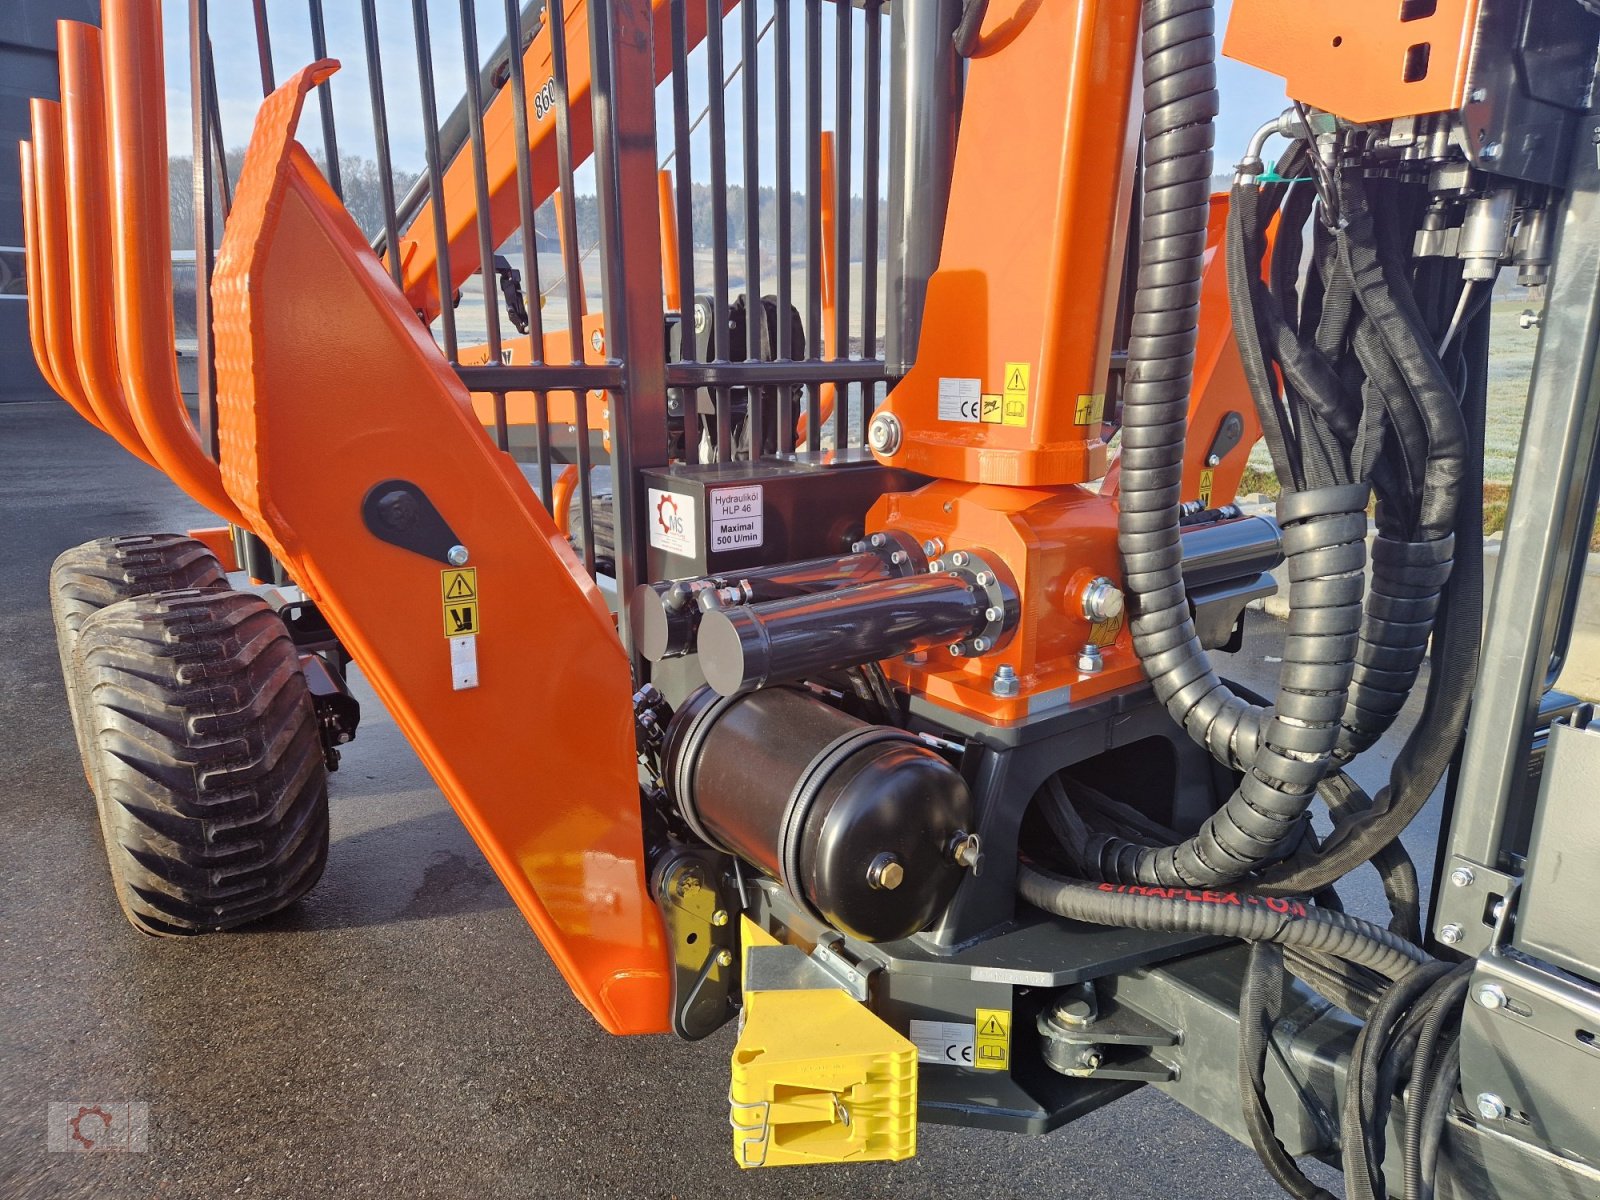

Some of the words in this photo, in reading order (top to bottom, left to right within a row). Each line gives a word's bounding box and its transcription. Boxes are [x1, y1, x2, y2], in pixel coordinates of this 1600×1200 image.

[715, 492, 759, 506] Hydrauliköl
[722, 505, 740, 515] HLP
[742, 504, 752, 513] 46
[720, 521, 754, 534] Maximal
[716, 536, 732, 545] 500
[734, 533, 758, 543] U/min
